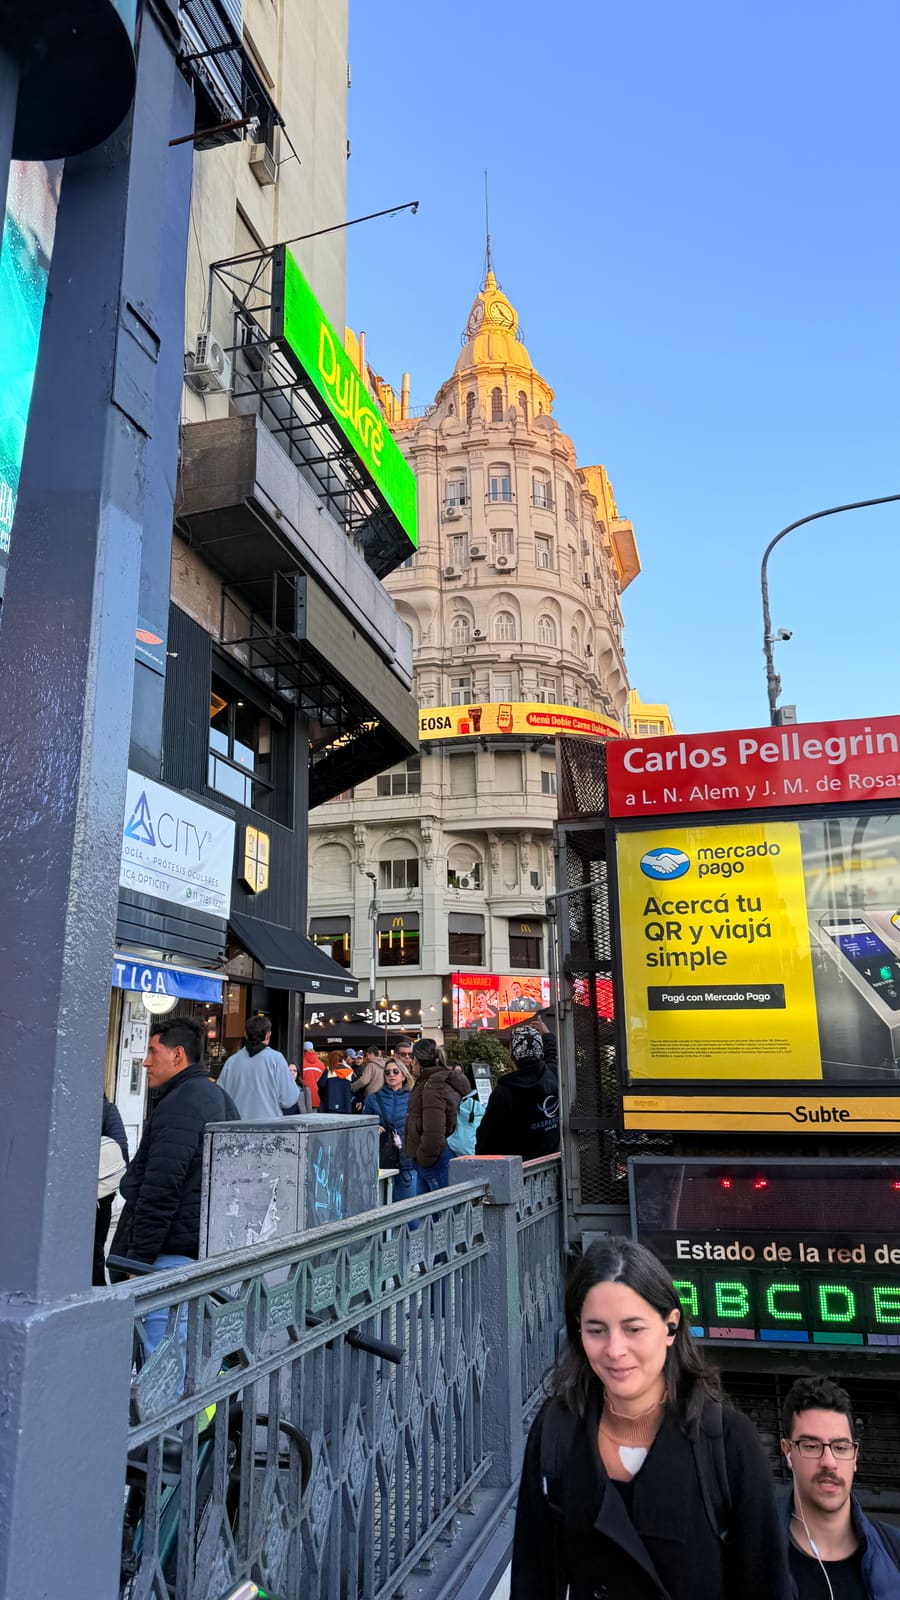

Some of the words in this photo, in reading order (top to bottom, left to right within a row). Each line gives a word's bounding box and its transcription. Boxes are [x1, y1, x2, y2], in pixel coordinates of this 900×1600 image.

[421, 716, 452, 731] EOSA
[551, 716, 572, 726] Doble
[623, 742, 726, 773] Carlos
[738, 727, 899, 765] Pellegrin
[625, 793, 636, 805] a
[642, 790, 657, 805] L.
[663, 787, 682, 803] N.
[689, 784, 739, 801] Alem
[745, 785, 756, 800] y
[762, 781, 776, 796] J.
[783, 778, 809, 793] M.
[816, 775, 841, 792] de
[157, 812, 208, 861] CITY
[697, 841, 780, 860] mercado
[698, 859, 744, 878] pago
[643, 893, 729, 916] Acercá
[736, 895, 762, 913] tu
[644, 921, 682, 943] QR
[689, 924, 704, 944] y
[710, 918, 772, 944] viajá
[646, 946, 728, 971] simple
[116, 963, 167, 993] TICA
[661, 993, 684, 1004] Pagá
[686, 994, 703, 1002] con
[704, 992, 745, 1001] Mercado
[746, 992, 771, 1003] Pago
[795, 1105, 850, 1123] Subte
[676, 1239, 755, 1261] Estado
[763, 1242, 792, 1262] de
[799, 1242, 820, 1263] la
[827, 1243, 866, 1264] red
[874, 1244, 900, 1264] de
[715, 1282, 750, 1318] B
[766, 1283, 802, 1320] C
[818, 1285, 856, 1322] D
